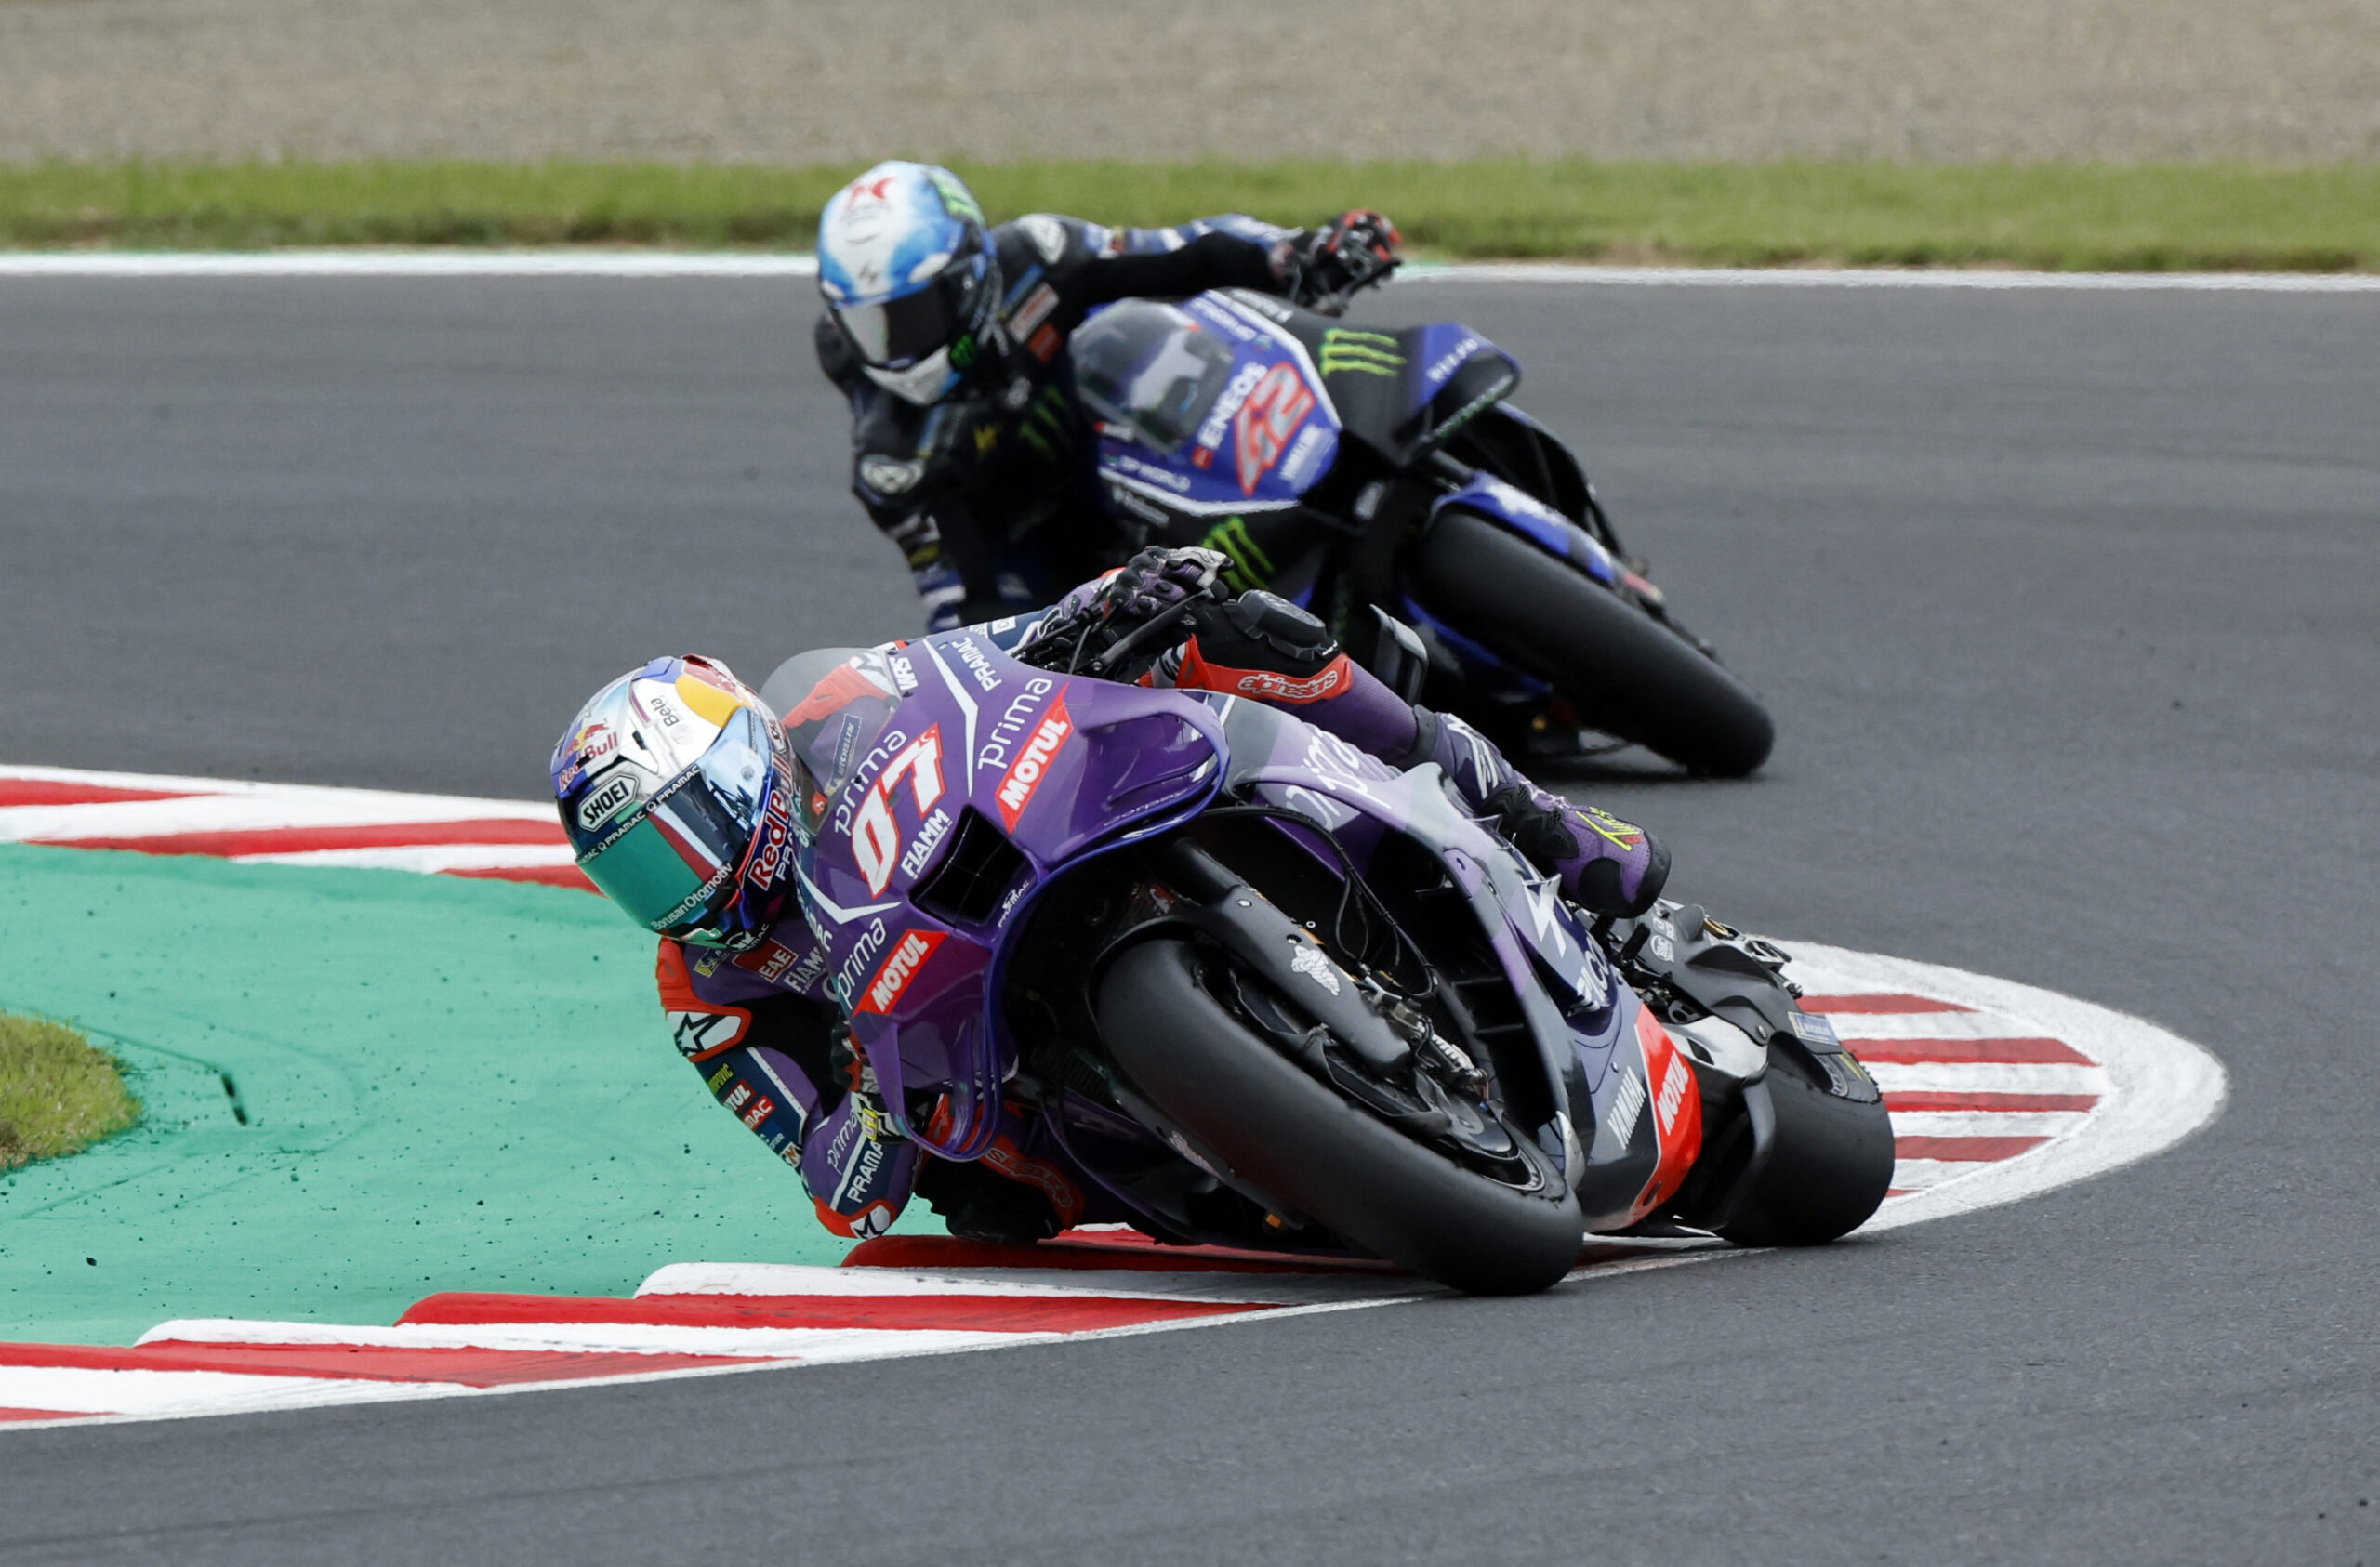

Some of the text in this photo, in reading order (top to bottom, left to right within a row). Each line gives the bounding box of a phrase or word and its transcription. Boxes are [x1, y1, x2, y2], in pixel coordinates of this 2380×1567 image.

[1235, 362, 1316, 497] 42
[951, 637, 1003, 691] PRAMAC
[650, 696, 680, 728] Beta
[978, 678, 1054, 770] prima
[582, 780, 629, 825] SHOEI
[656, 765, 701, 808] PRAMAC
[834, 730, 908, 837] prima
[999, 718, 1069, 811] MOTUL
[604, 810, 646, 847] PRAMAC
[747, 810, 787, 891] Red
[851, 724, 947, 899] 07
[900, 808, 952, 879] FIAMM
[651, 863, 734, 930] Borusan Otomotiv
[837, 916, 887, 1011] prima
[870, 932, 930, 1013] MOTUL
[1606, 1065, 1647, 1150] YAMAHA
[1656, 1049, 1689, 1137] MOTUL
[847, 1141, 884, 1204] PRAMA
